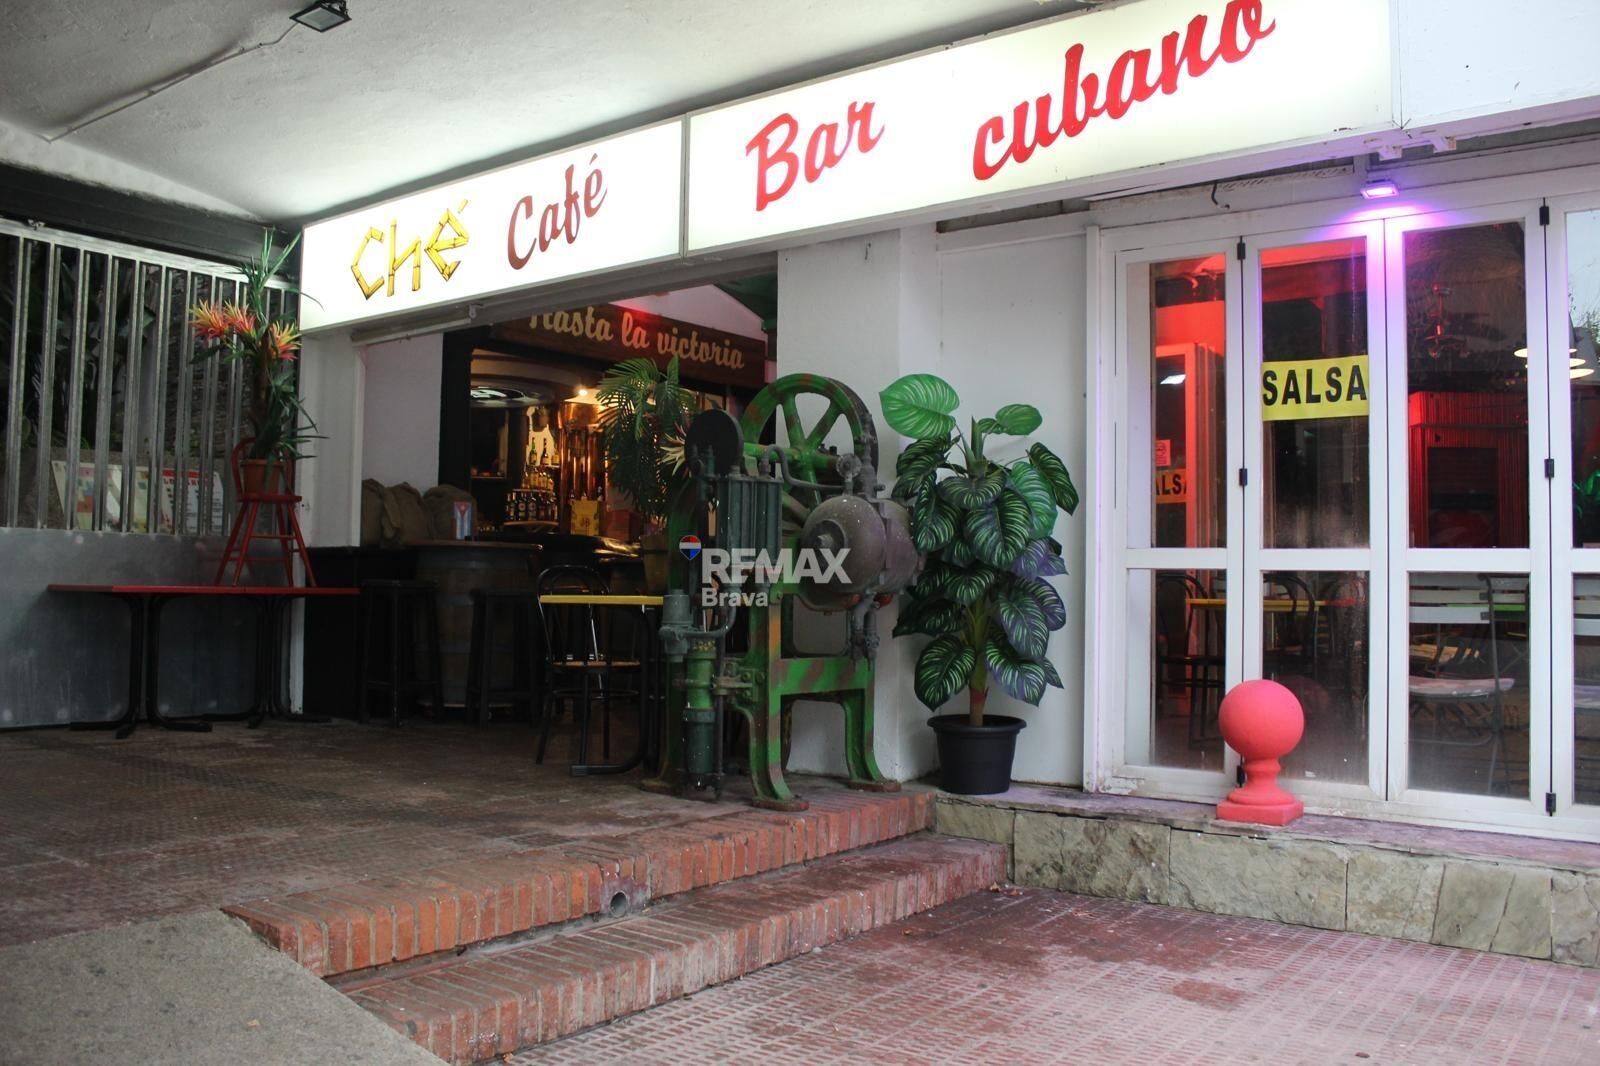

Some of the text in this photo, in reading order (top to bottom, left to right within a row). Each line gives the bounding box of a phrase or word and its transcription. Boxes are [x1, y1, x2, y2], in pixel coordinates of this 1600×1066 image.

[745, 0, 1277, 212] Bar cubano
[507, 152, 608, 270] Café
[621, 311, 650, 349] la
[656, 327, 745, 370] victoria
[1262, 364, 1368, 406] SALSA
